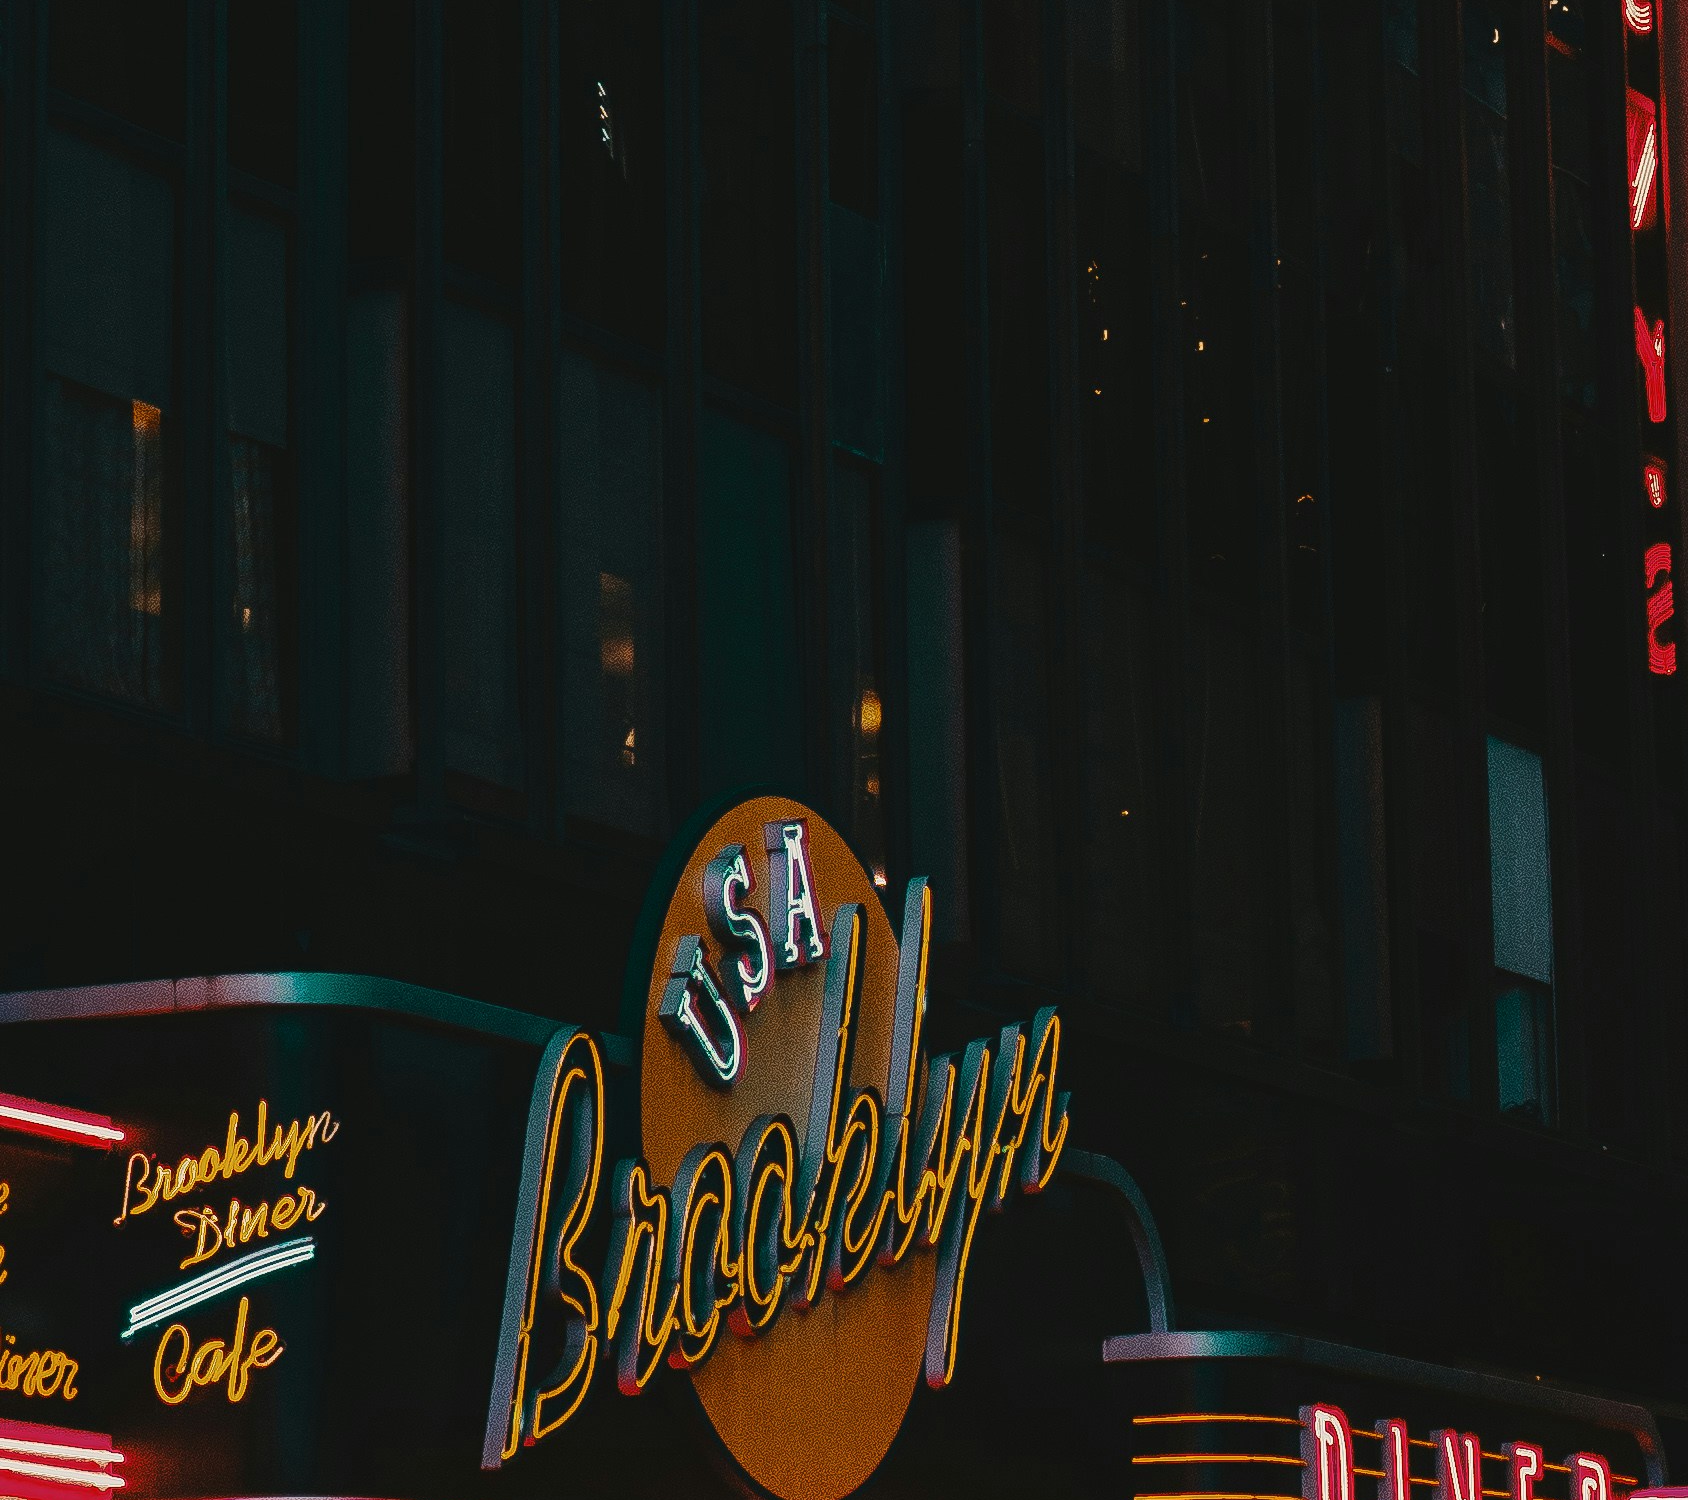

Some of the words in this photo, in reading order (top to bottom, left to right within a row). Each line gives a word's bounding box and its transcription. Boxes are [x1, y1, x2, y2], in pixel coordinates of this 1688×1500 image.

[662, 817, 831, 1090] USA
[114, 1099, 340, 1226] Brooklyn
[482, 876, 1072, 1468] Brooklyn
[173, 1186, 328, 1269] Diner
[0, 1333, 79, 1400] iner
[154, 1296, 287, 1404] Cafe
